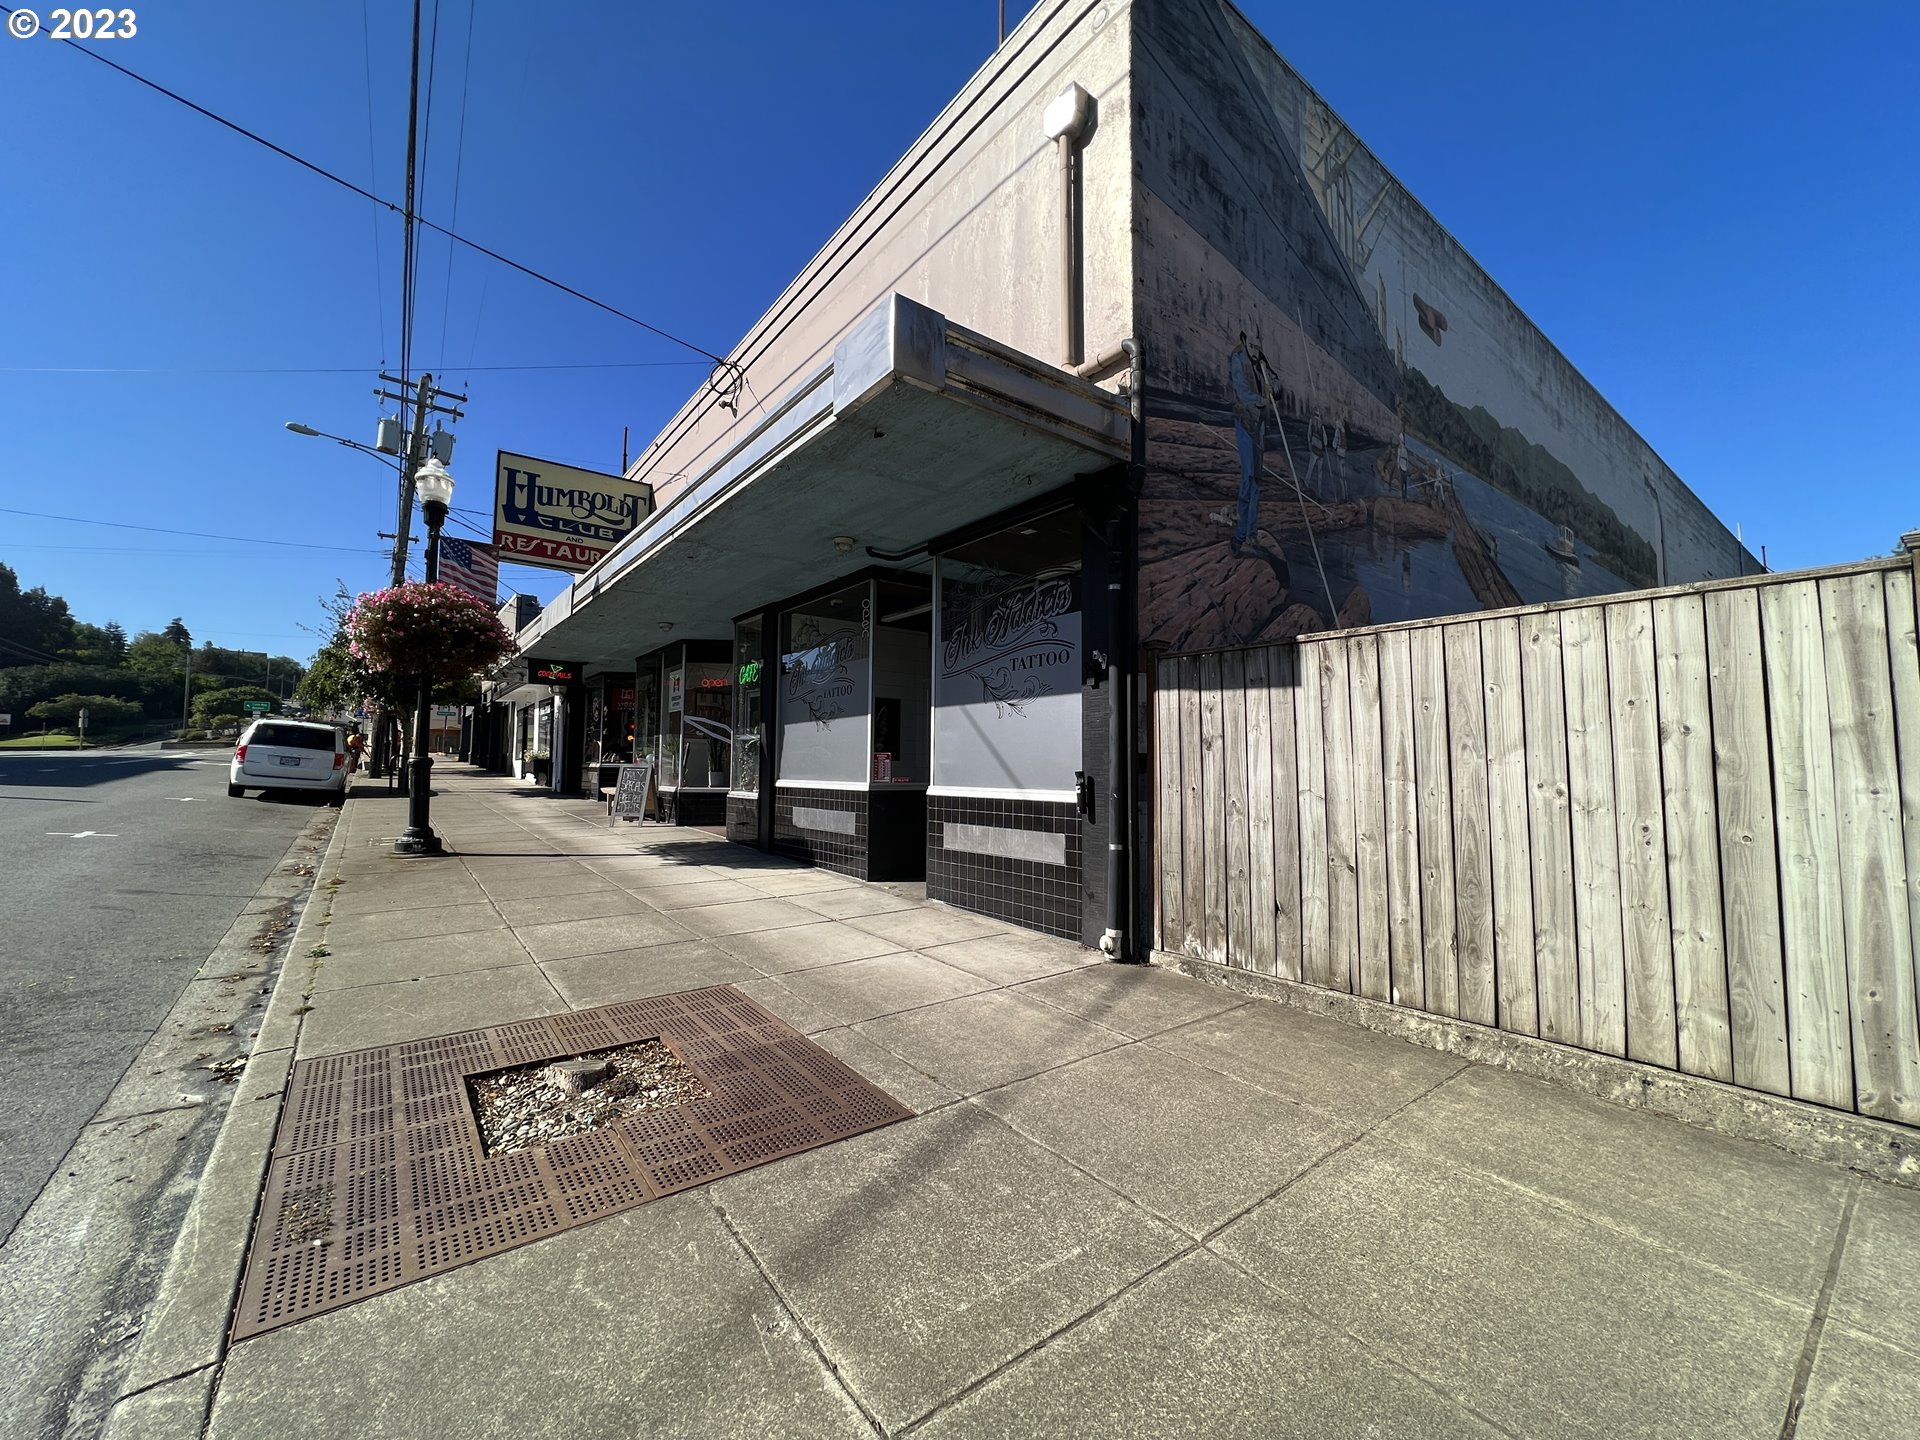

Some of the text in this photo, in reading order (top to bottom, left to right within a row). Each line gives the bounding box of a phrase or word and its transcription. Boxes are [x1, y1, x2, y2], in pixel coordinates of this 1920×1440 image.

[537, 516, 614, 539] CLUB
[565, 536, 584, 544] AND
[1009, 649, 1071, 672] TATTOO
